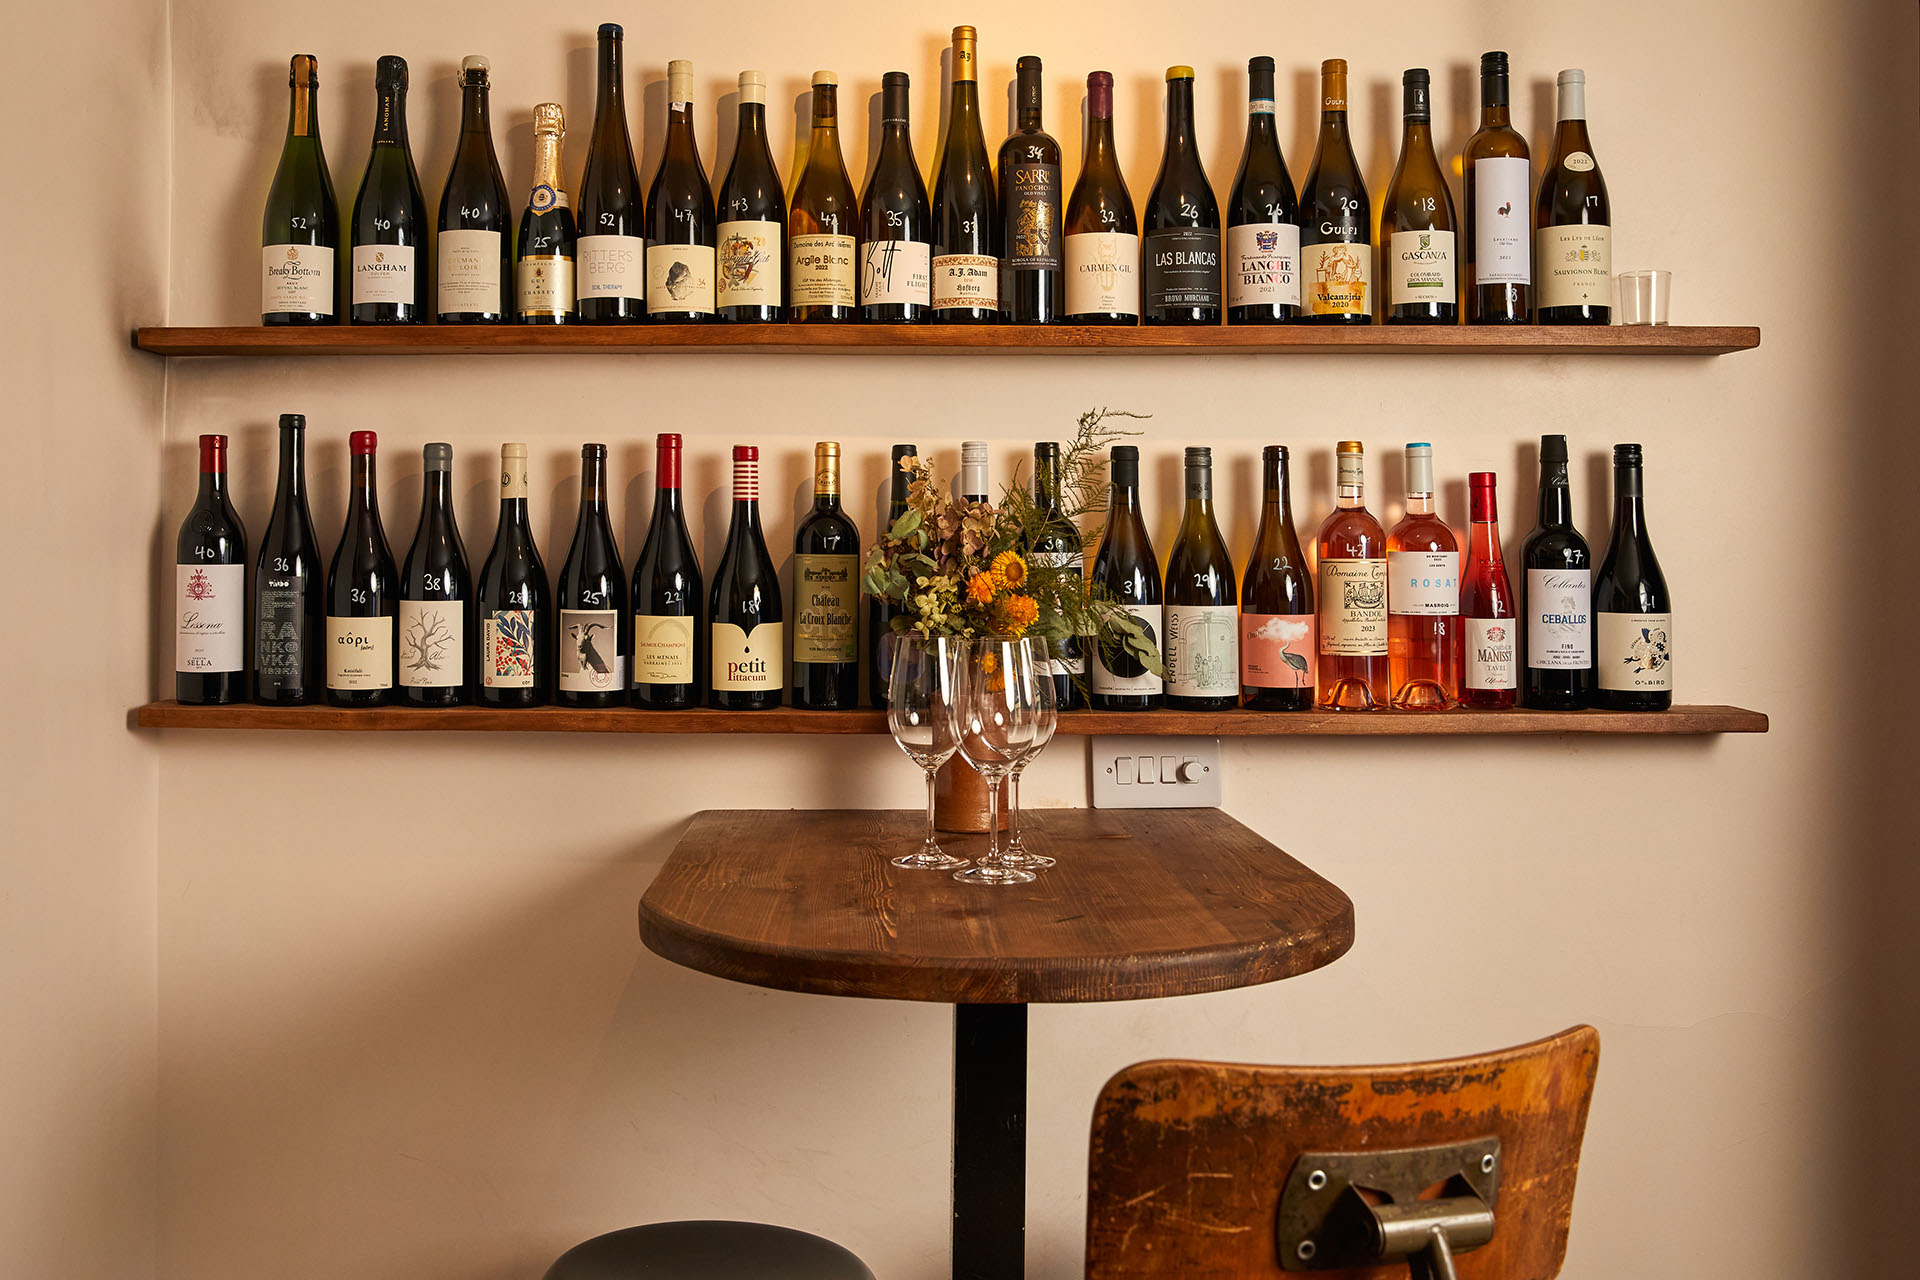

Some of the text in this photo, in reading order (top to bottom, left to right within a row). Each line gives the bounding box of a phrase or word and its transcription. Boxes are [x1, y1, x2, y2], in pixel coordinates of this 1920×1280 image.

[1027, 146, 1044, 160] 34
[732, 198, 748, 212] 43
[1340, 196, 1358, 210] 20
[1422, 196, 1436, 212] 18
[1586, 196, 1598, 207] 17
[461, 206, 480, 218] 40
[674, 208, 692, 222] 47
[1100, 210, 1116, 223] 32
[1180, 204, 1198, 218] 26
[1266, 203, 1283, 216] 26
[291, 217, 306, 230] 52
[374, 218, 390, 230] 40
[600, 212, 614, 227] 52
[886, 210, 903, 226] 35
[534, 236, 551, 248] 25
[825, 240, 851, 248] Ardisières
[584, 250, 632, 262] RITTERS
[796, 255, 820, 266] Argile
[1156, 252, 1216, 266] LAS BLANCAS
[292, 266, 320, 277] Bottom
[358, 264, 406, 272] LANGHAM
[590, 262, 625, 274] BERG
[1080, 264, 1117, 273] CARMEN
[1242, 260, 1291, 272] LANGHE
[1244, 274, 1290, 285] BIANCO
[824, 535, 841, 550] 17
[1346, 542, 1365, 557] 42
[195, 546, 215, 560] 40
[1563, 548, 1583, 564] 27
[274, 558, 289, 572] 36
[1273, 556, 1292, 570] 22
[1326, 565, 1368, 577] Domaine
[424, 574, 441, 590] 38
[1194, 574, 1211, 588] 29
[1411, 578, 1457, 588] ROSAT
[1543, 574, 1586, 589] Collantes
[351, 588, 366, 604] 36
[509, 591, 524, 604] 28
[583, 590, 602, 605] 25
[664, 591, 682, 604] 22
[812, 594, 840, 607] Château
[181, 612, 224, 630] Lessona
[800, 612, 807, 625] La
[807, 612, 825, 625] Croix
[1542, 614, 1586, 624] CEBALLOS
[1434, 622, 1446, 636] 18
[1477, 648, 1512, 662] MANISSY
[728, 658, 766, 678] petit
